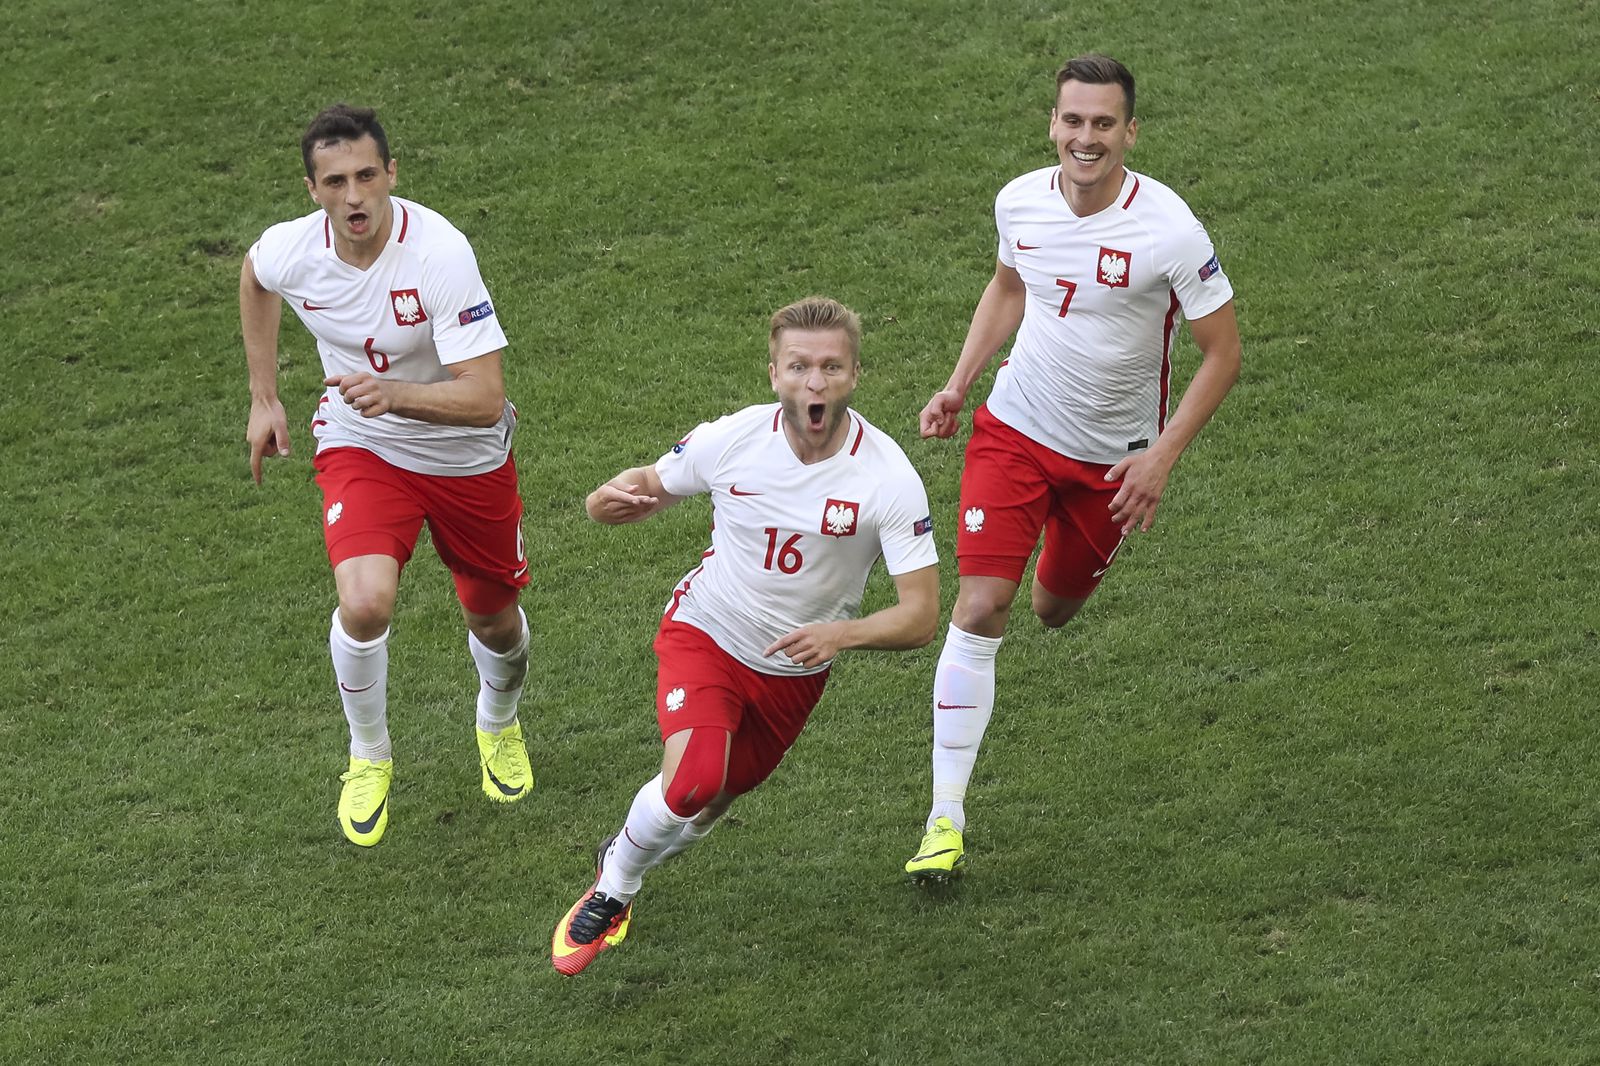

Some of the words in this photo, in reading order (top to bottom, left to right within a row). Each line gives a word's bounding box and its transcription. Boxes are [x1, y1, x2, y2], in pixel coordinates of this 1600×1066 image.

[1055, 278, 1078, 318] 7
[363, 337, 390, 373] 6
[763, 527, 804, 575] 16
